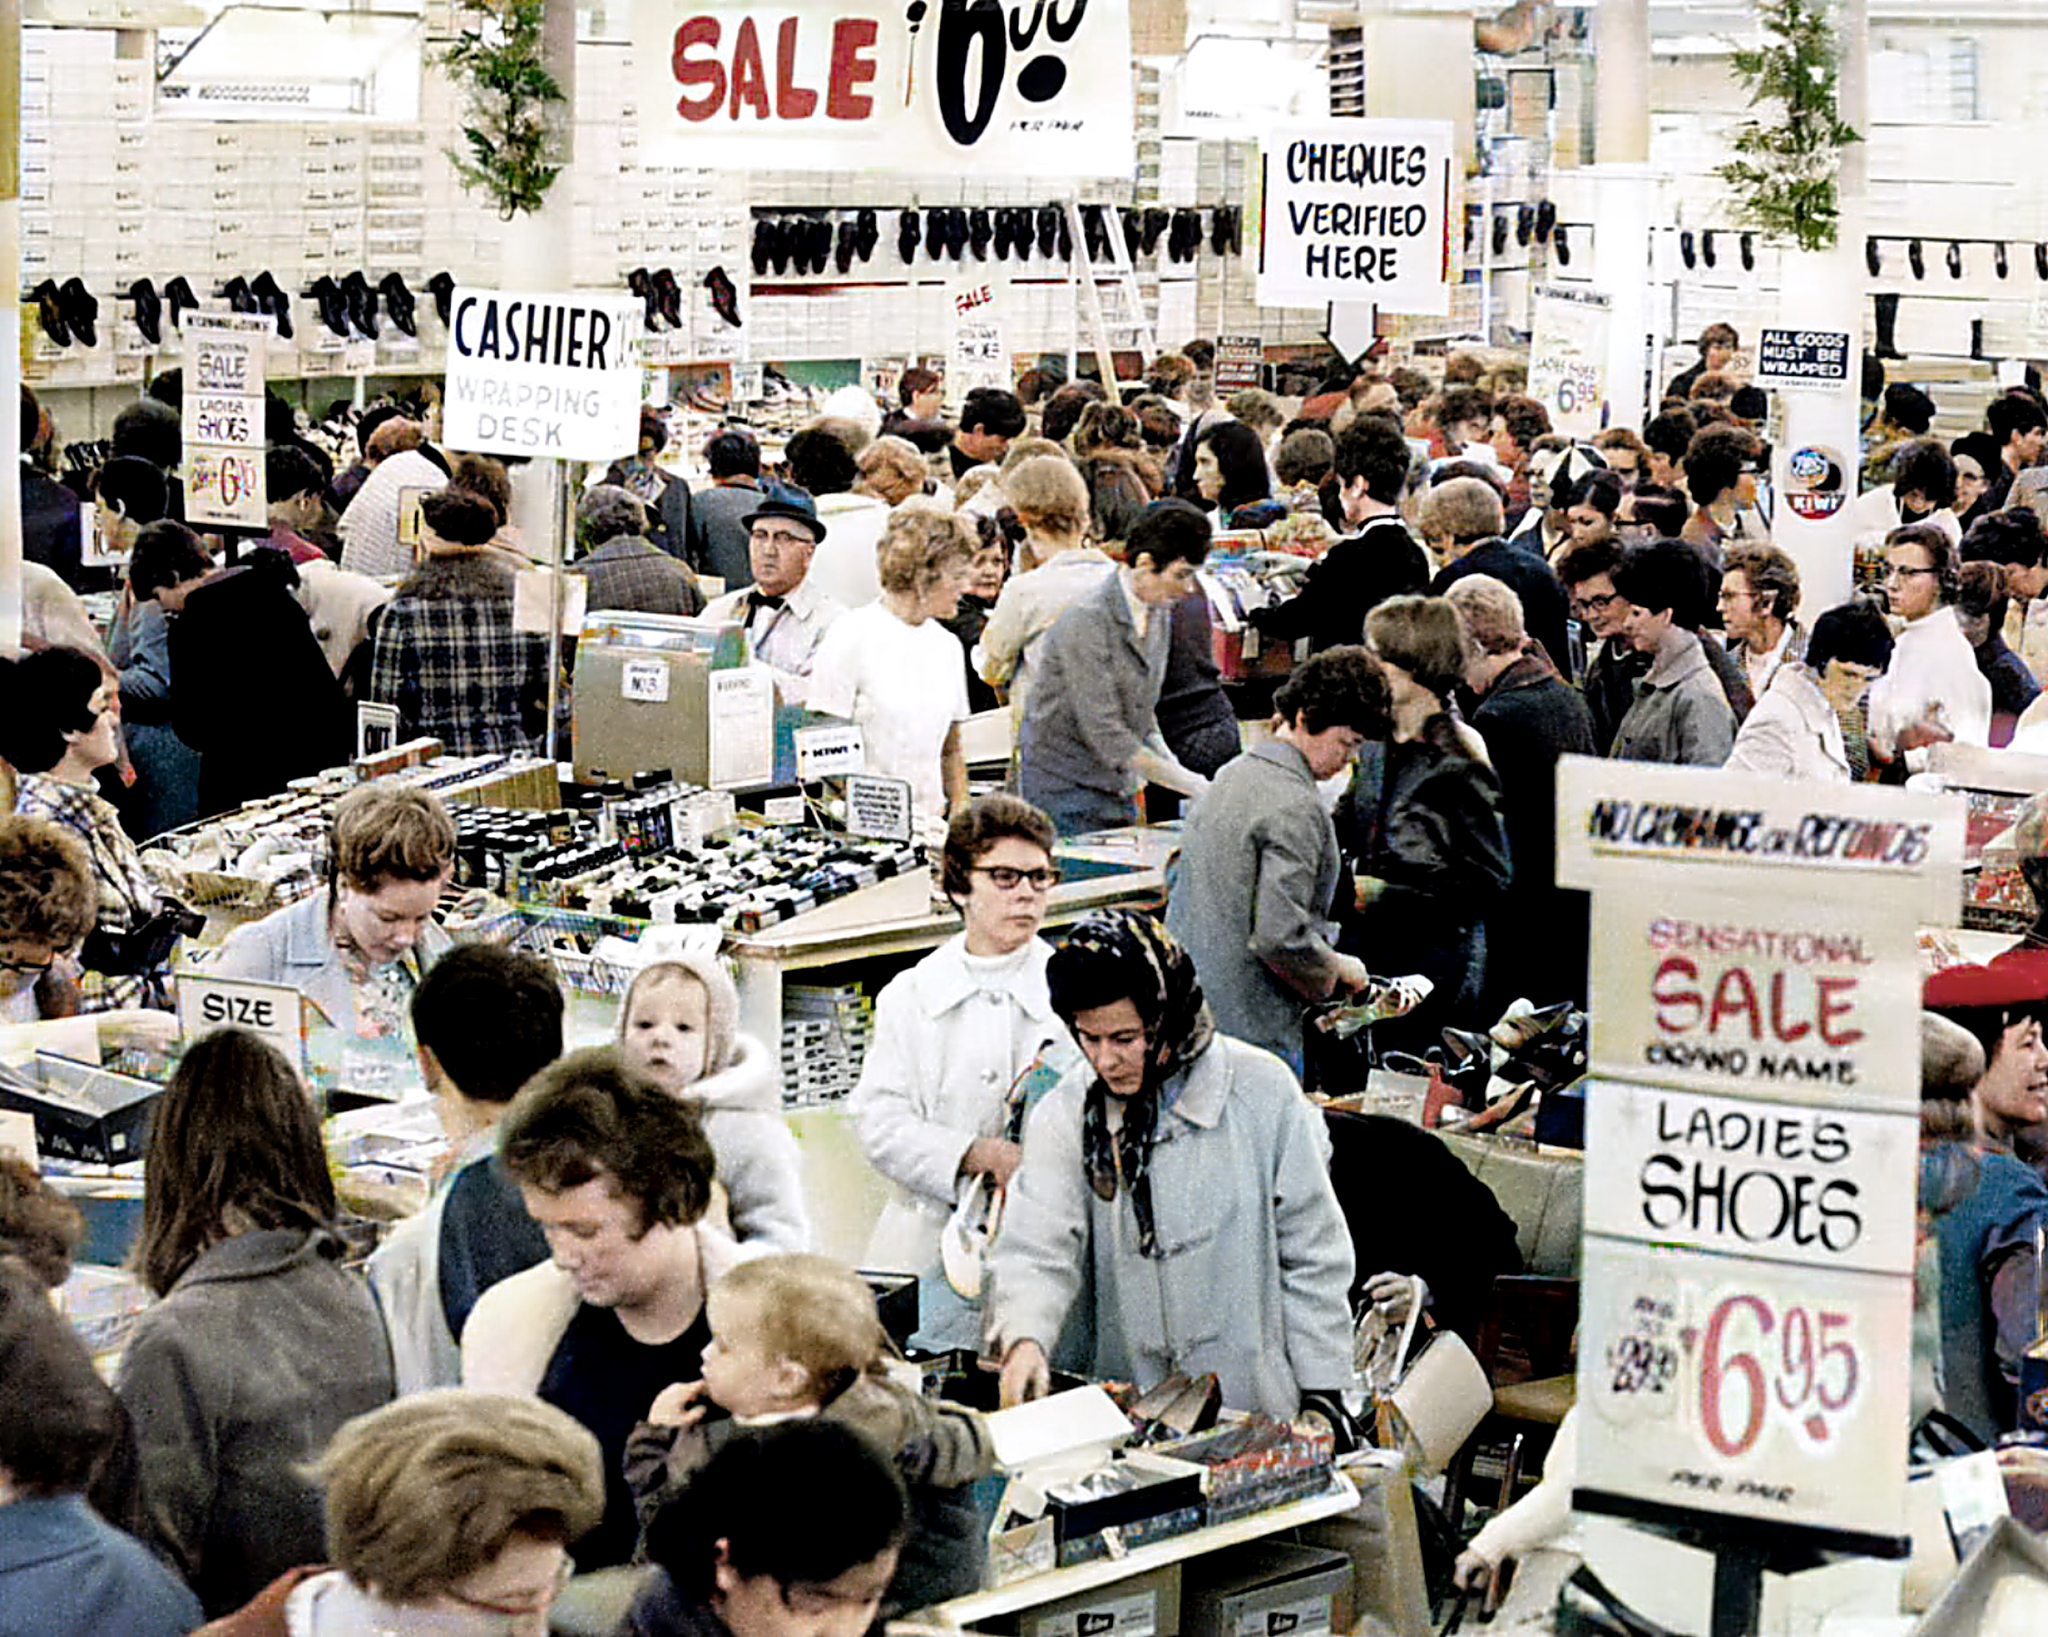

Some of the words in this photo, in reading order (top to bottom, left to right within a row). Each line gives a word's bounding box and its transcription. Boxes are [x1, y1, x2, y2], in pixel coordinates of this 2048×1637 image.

[672, 16, 878, 122] SALE
[1287, 141, 1426, 188] CHEQUES
[1288, 201, 1426, 237] VERIFIED
[1306, 244, 1397, 284] HERE
[455, 297, 611, 370] CASHIER
[1763, 332, 1791, 346] ALL
[1794, 334, 1845, 347] GOODS
[199, 353, 246, 379] SALE
[1761, 361, 1843, 377] WRAPPED
[1762, 346, 1808, 361] MUST
[1817, 349, 1842, 363] BE
[456, 376, 601, 417] WRAPPING
[198, 414, 249, 442] SHOES
[477, 413, 563, 447] DESK
[1793, 497, 1839, 510] KIWI
[813, 745, 848, 758] KIWI
[1649, 919, 1874, 965] SENSATIONAL
[203, 993, 274, 1026] SIZE
[1653, 957, 1865, 1045] SALE
[1760, 1056, 1857, 1085] NAME
[1658, 1101, 1850, 1163] LADIES
[1641, 1154, 1863, 1251] SHOES
